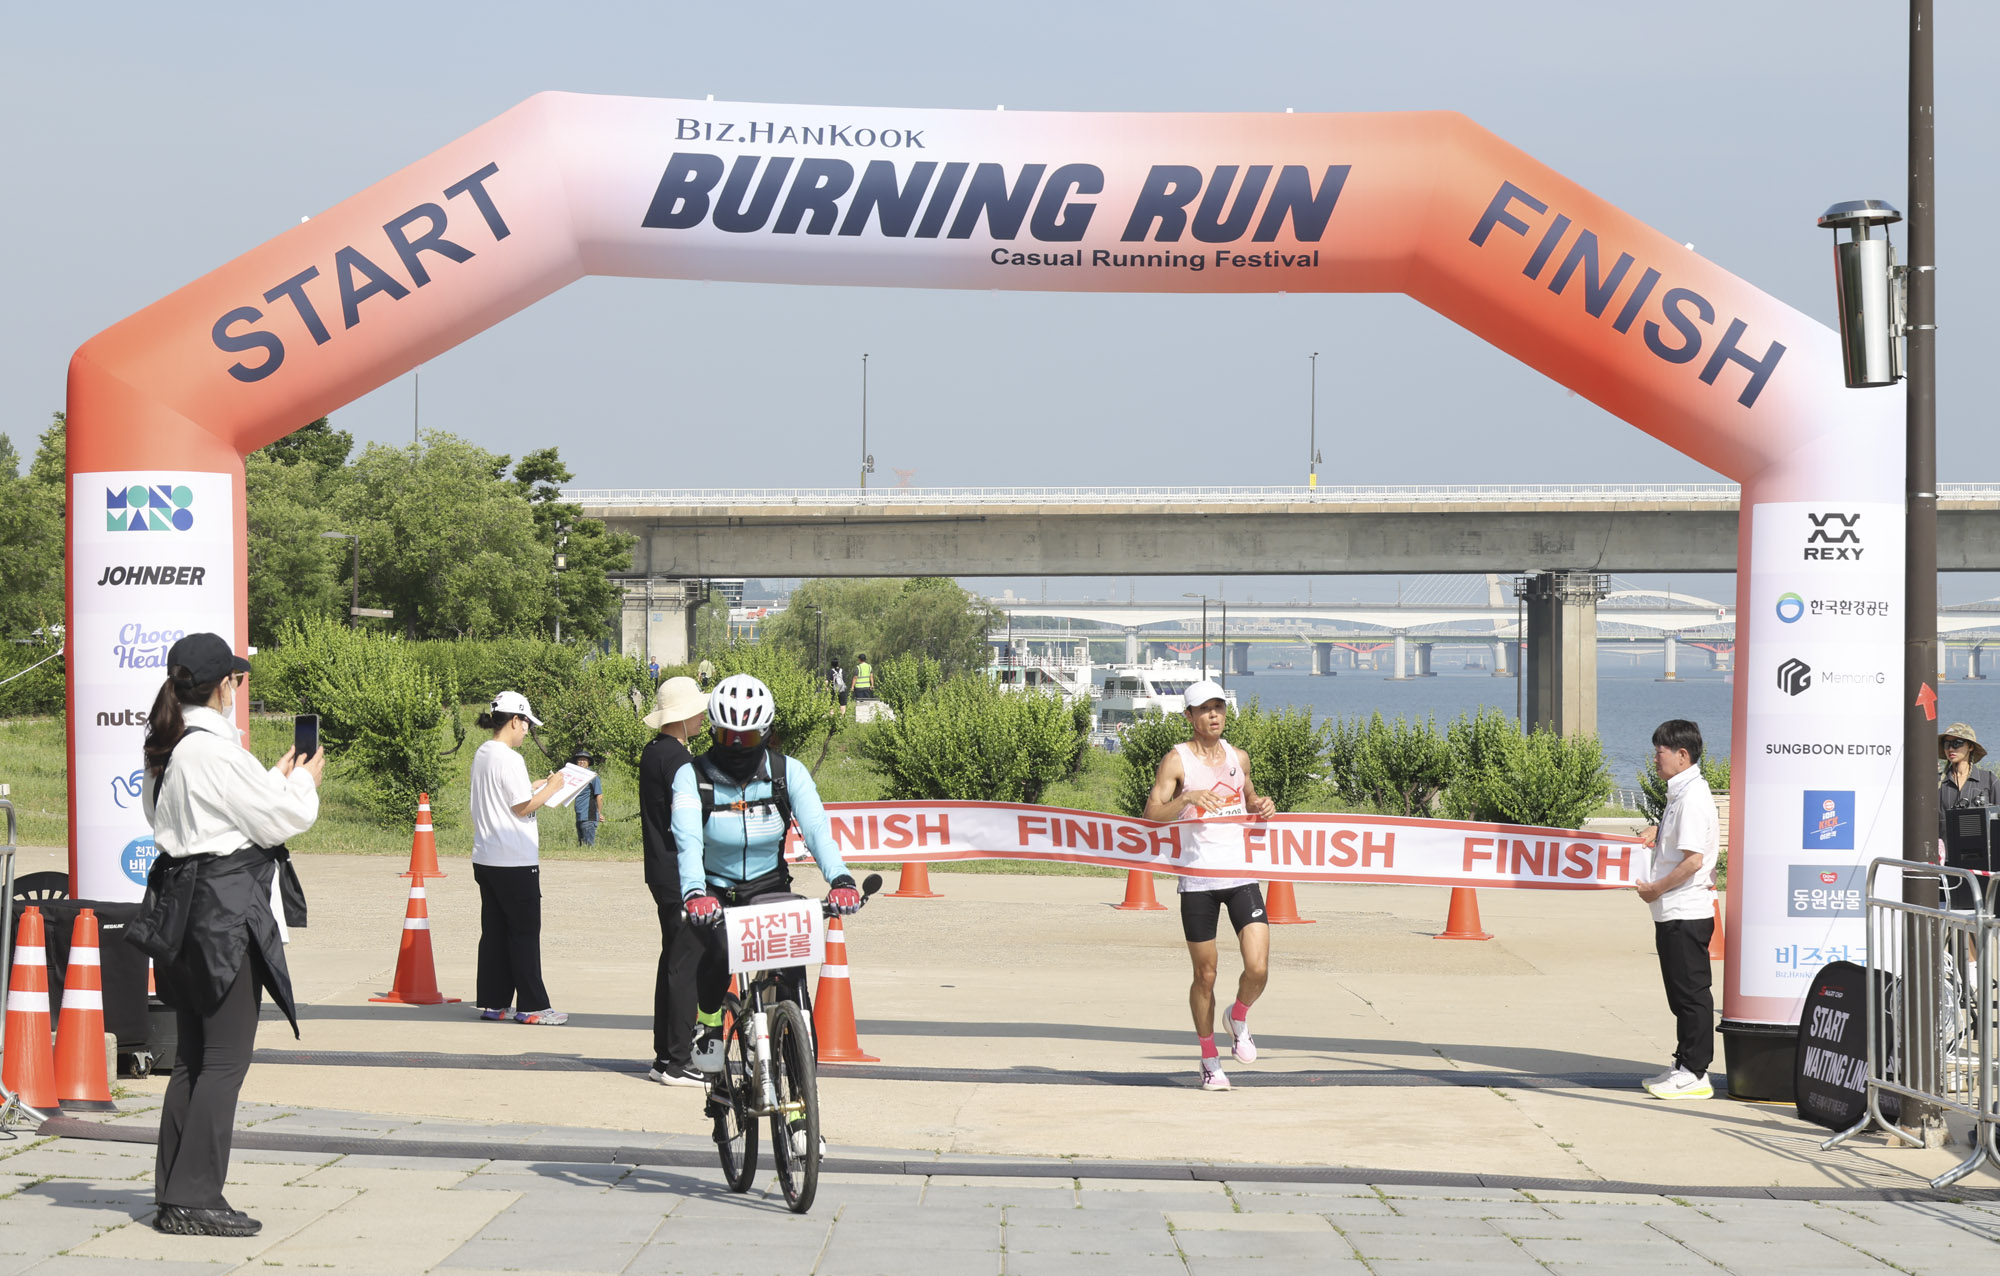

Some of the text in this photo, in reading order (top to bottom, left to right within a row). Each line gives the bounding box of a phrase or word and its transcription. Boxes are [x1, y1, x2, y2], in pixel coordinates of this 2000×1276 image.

[641, 151, 1353, 244] BURNING RUN
[211, 161, 511, 383] START
[990, 247, 1320, 272] Casual Running Festival
[1468, 180, 1787, 409] FINISH
[106, 485, 193, 508] MONO
[106, 508, 194, 532] MANO
[1803, 547, 1864, 561] REXY
[97, 566, 206, 586] JOHNBER
[1810, 599, 1889, 616] 한국환경공단
[119, 623, 185, 645] Choco
[113, 645, 168, 669] Heal
[96, 709, 148, 726] nuts
[1765, 743, 1892, 756] SUNGBOON EDITOR
[785, 813, 951, 852] FNISH
[1017, 815, 1182, 859] FINISH
[1243, 828, 1395, 868] FINISH
[1462, 836, 1632, 881] FINISH
[1793, 889, 1862, 911] 동원샘물
[739, 910, 812, 941] 자전거
[741, 933, 811, 963] 페트롤
[1810, 1005, 1851, 1043] START
[1803, 1046, 1848, 1086] WAITING
[1843, 1057, 1869, 1094] LINE
